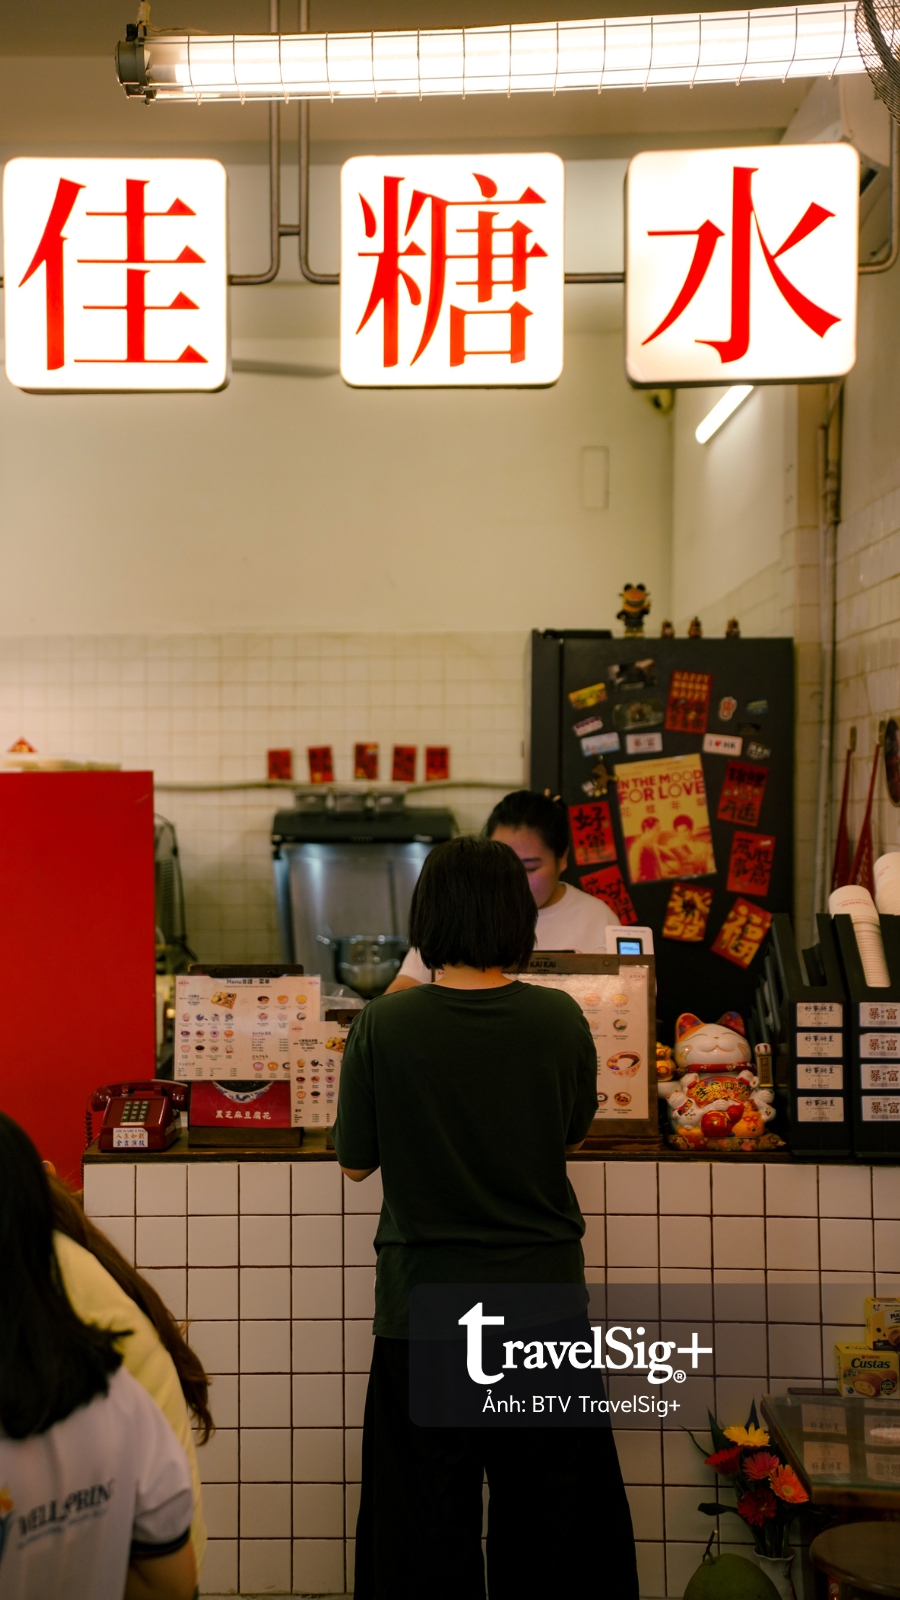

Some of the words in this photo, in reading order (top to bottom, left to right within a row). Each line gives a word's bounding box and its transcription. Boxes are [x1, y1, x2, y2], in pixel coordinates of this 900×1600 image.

[19, 167, 841, 371] 佳糖水
[617, 779, 630, 790] IN
[632, 774, 657, 788] THE
[658, 769, 703, 784] MOOD
[618, 787, 655, 806] FOR
[658, 781, 706, 800] LOVE
[215, 1109, 272, 1121] 黑芝麻豆腐花
[850, 1357, 891, 1369] Custas
